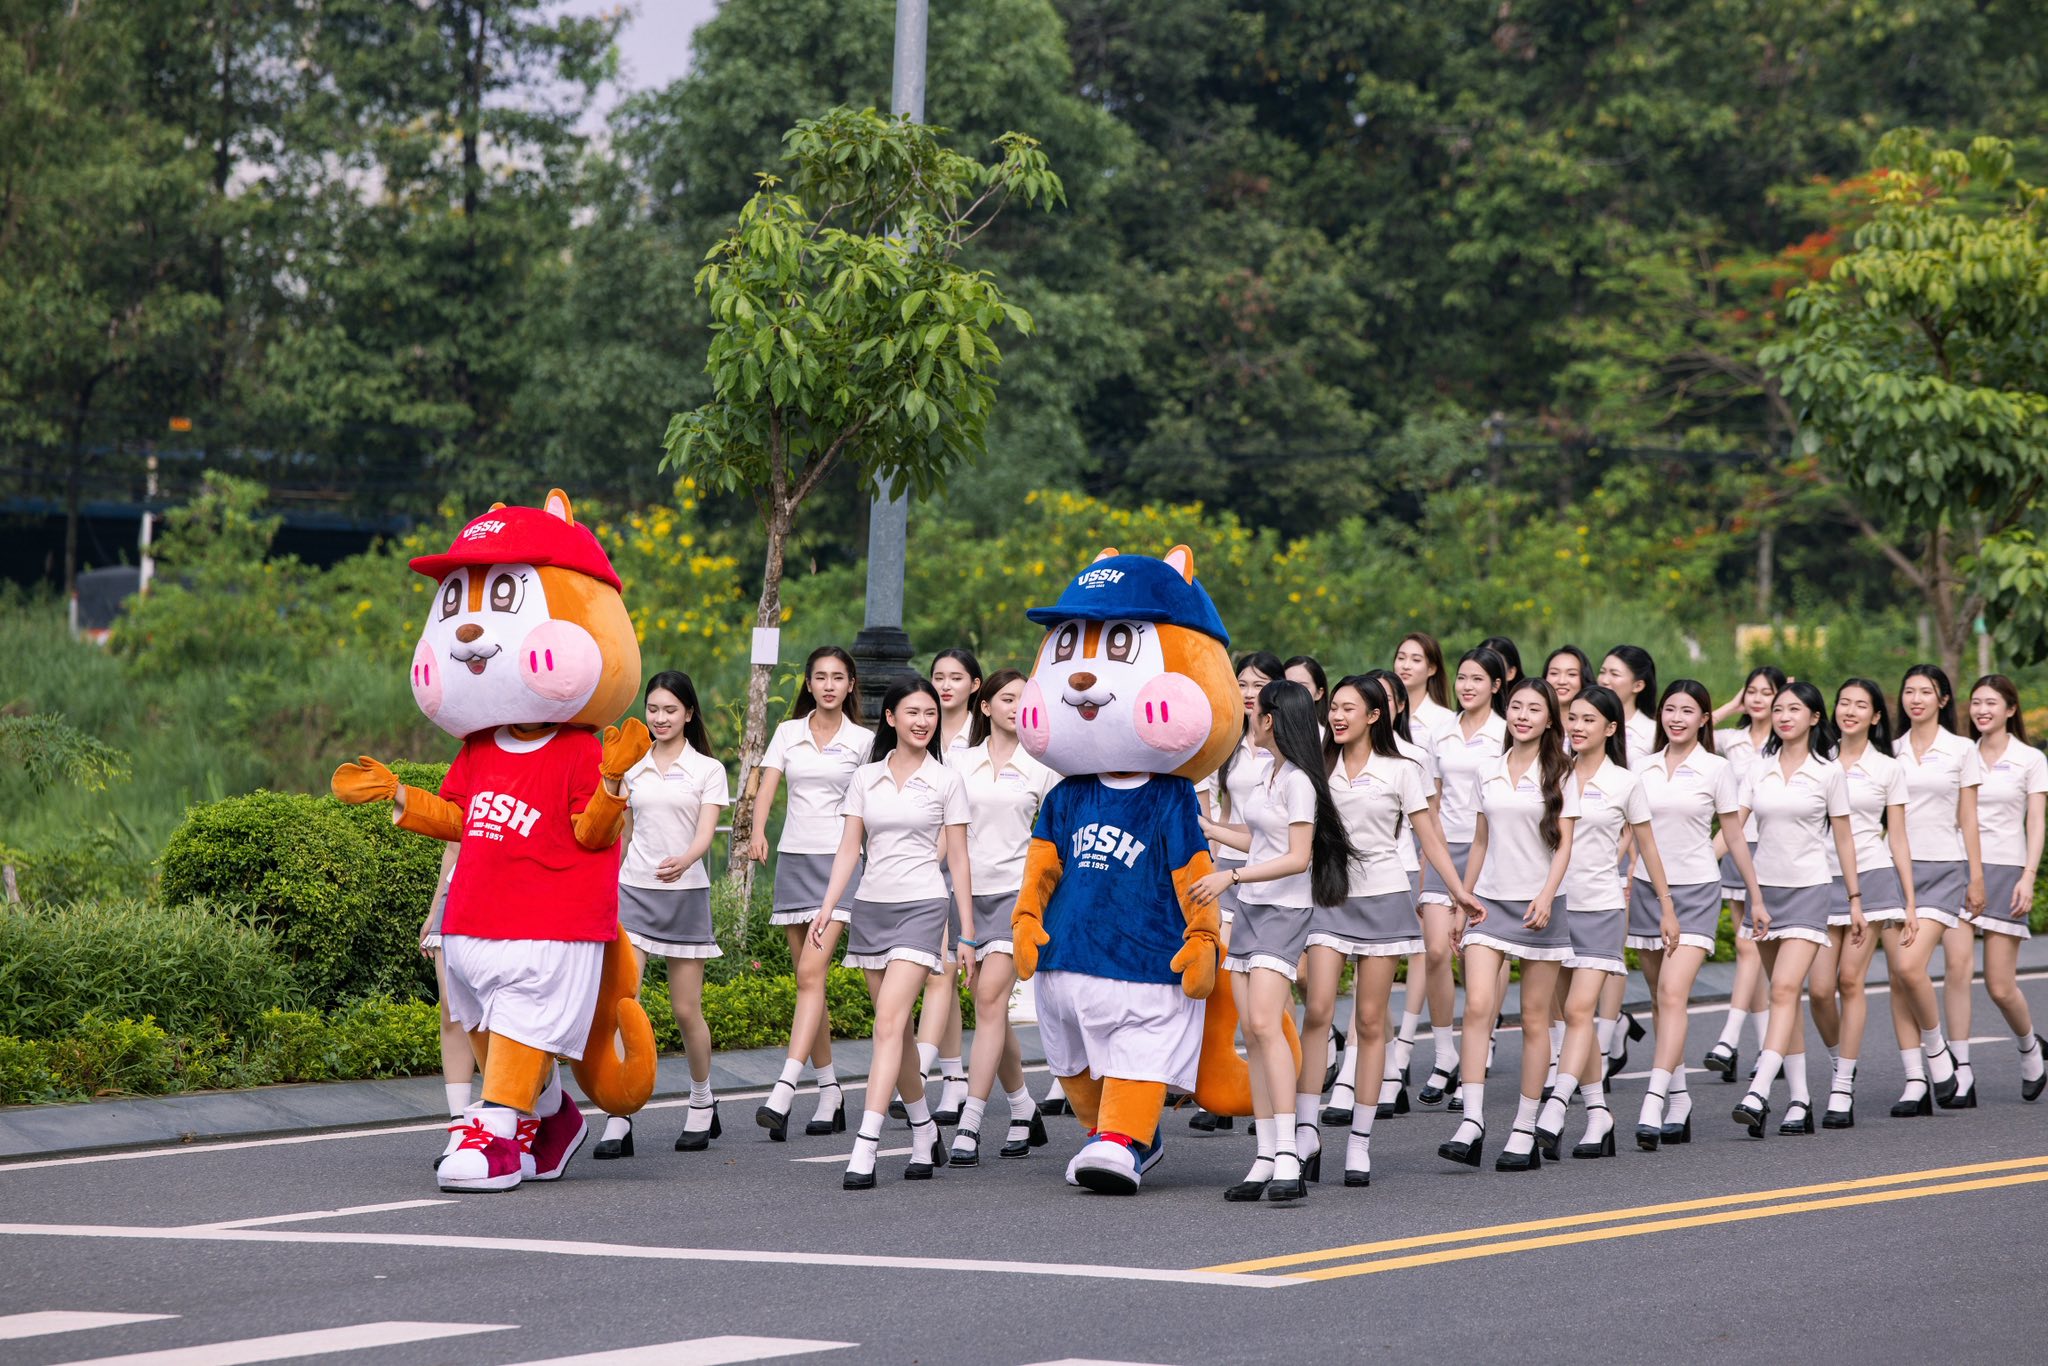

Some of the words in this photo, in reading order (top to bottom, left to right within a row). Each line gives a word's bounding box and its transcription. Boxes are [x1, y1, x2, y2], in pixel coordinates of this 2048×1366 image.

[463, 520, 506, 538] USSH
[1078, 569, 1125, 585] USSH
[486, 832, 504, 841] 1957
[1072, 823, 1146, 869] USSH
[1091, 862, 1109, 870] 1957
